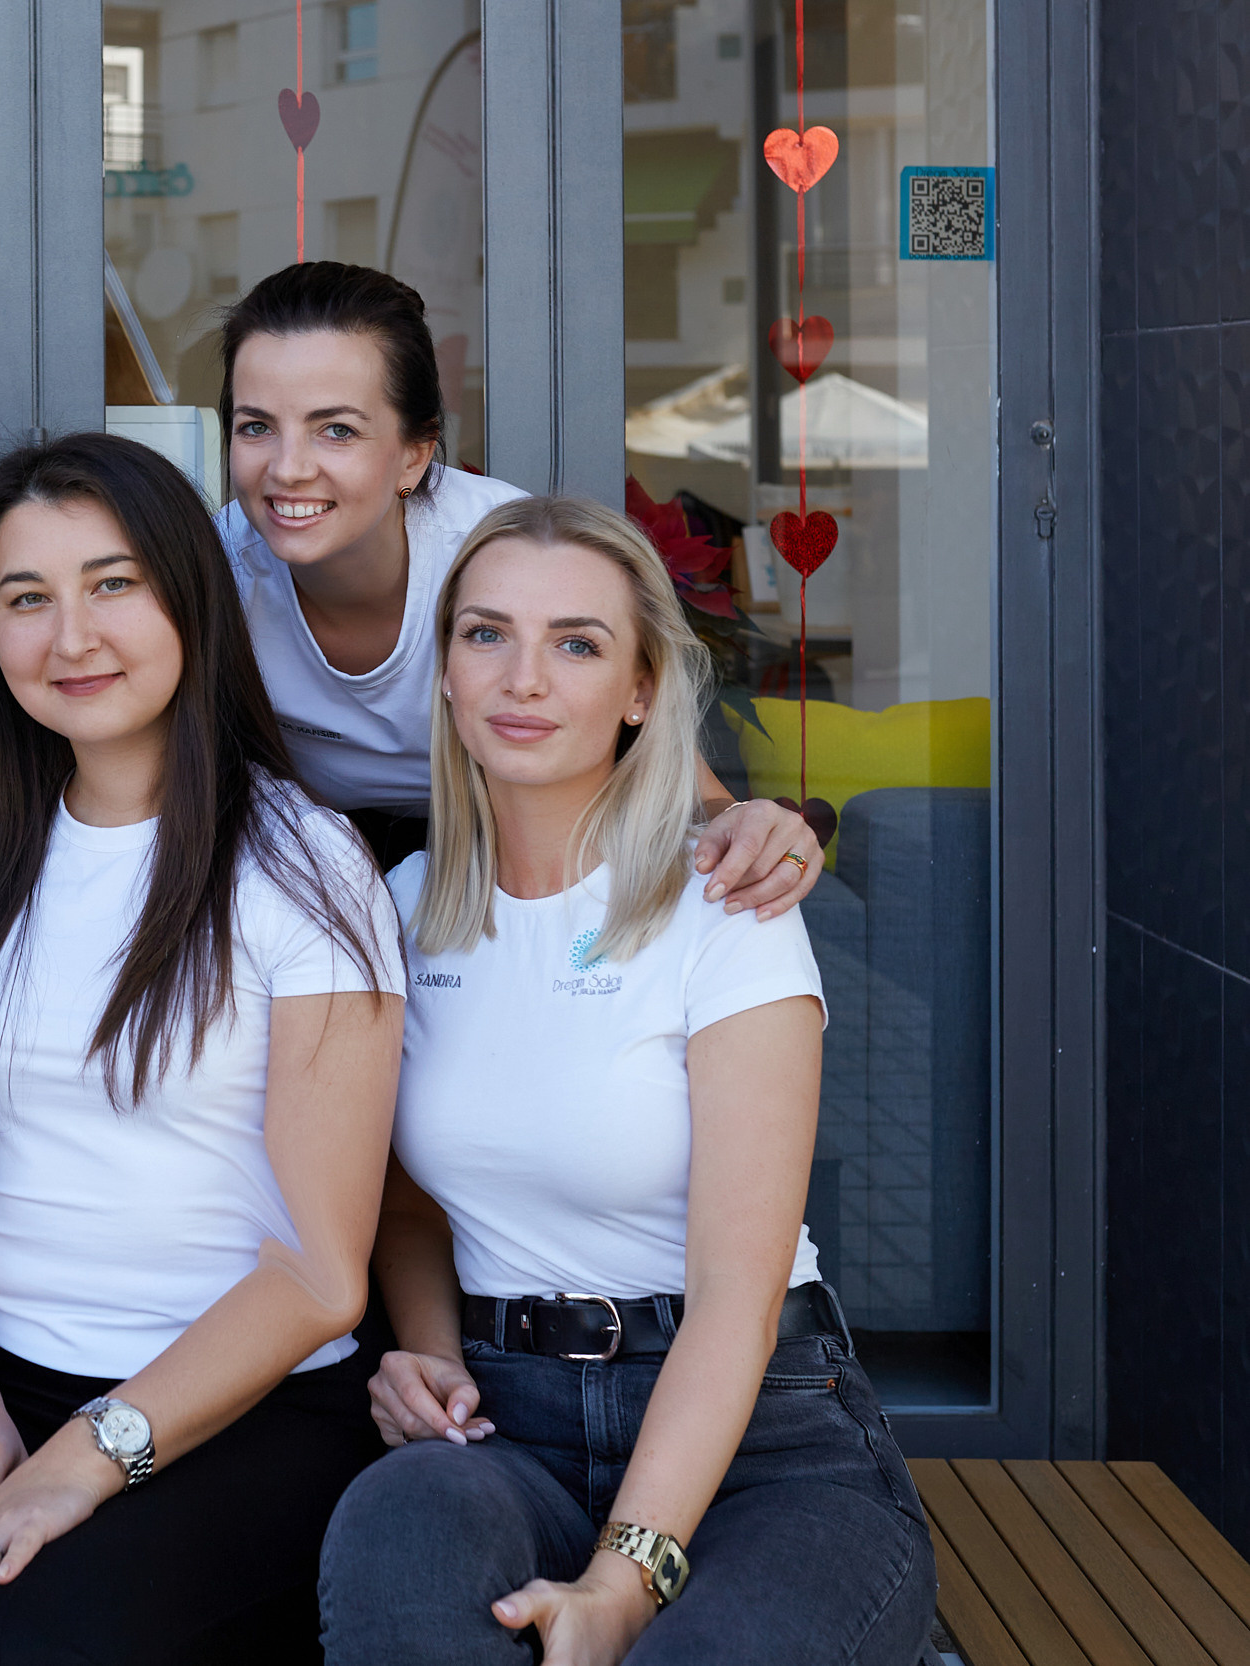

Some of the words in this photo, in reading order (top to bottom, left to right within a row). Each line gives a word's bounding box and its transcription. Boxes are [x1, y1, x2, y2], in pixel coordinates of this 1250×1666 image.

[915, 167, 948, 178] Dream
[952, 167, 980, 178] Salon
[414, 972, 461, 988] SANDRA
[552, 978, 585, 993] Dream
[588, 974, 623, 988] Salon
